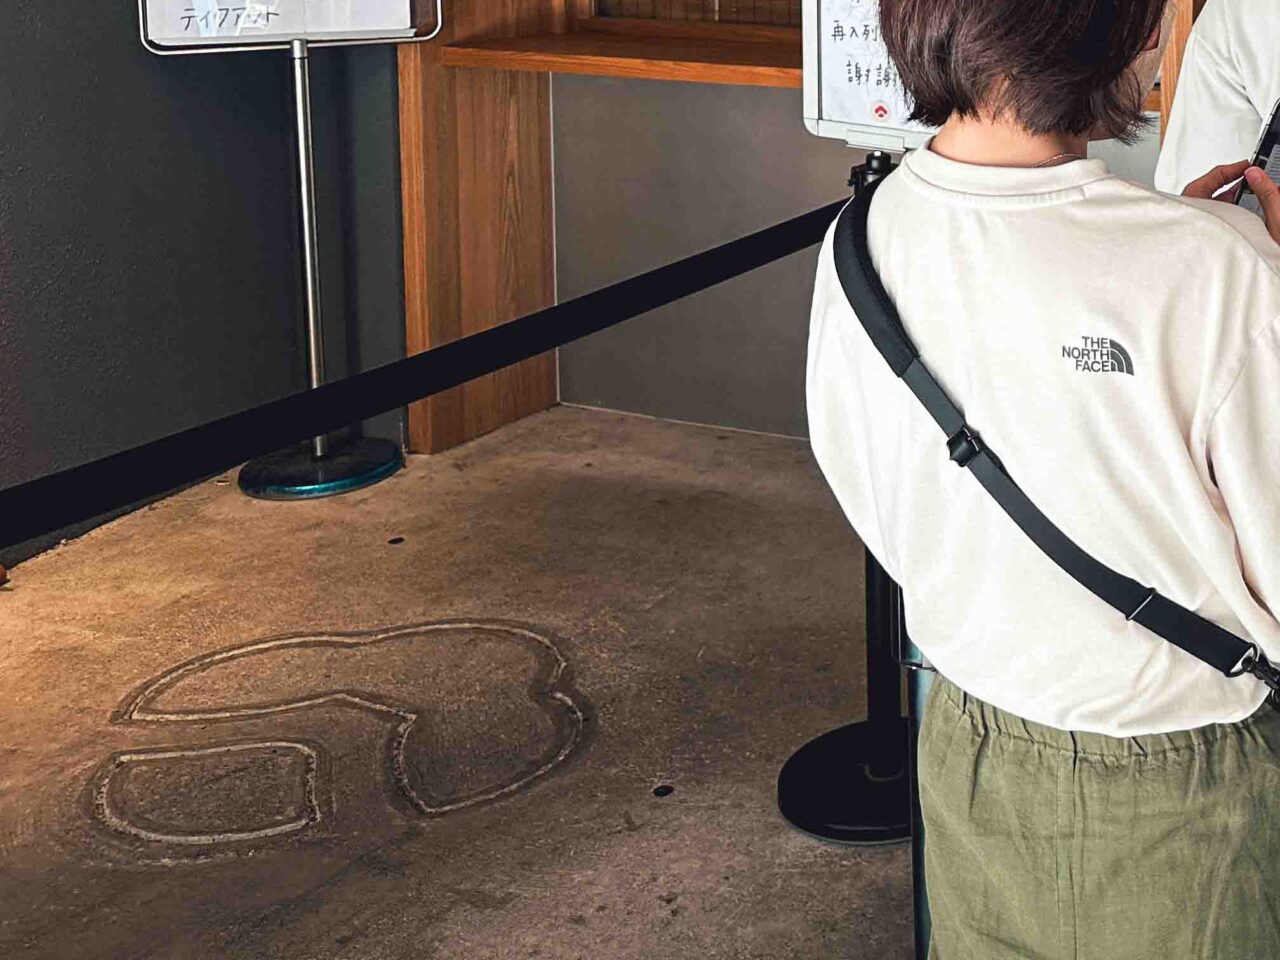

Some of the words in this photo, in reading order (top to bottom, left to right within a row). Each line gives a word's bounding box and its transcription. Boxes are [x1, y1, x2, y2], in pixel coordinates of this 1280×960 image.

[1081, 336, 1108, 349] THE
[1062, 345, 1110, 360] NORTH
[1075, 359, 1110, 373] FACE
